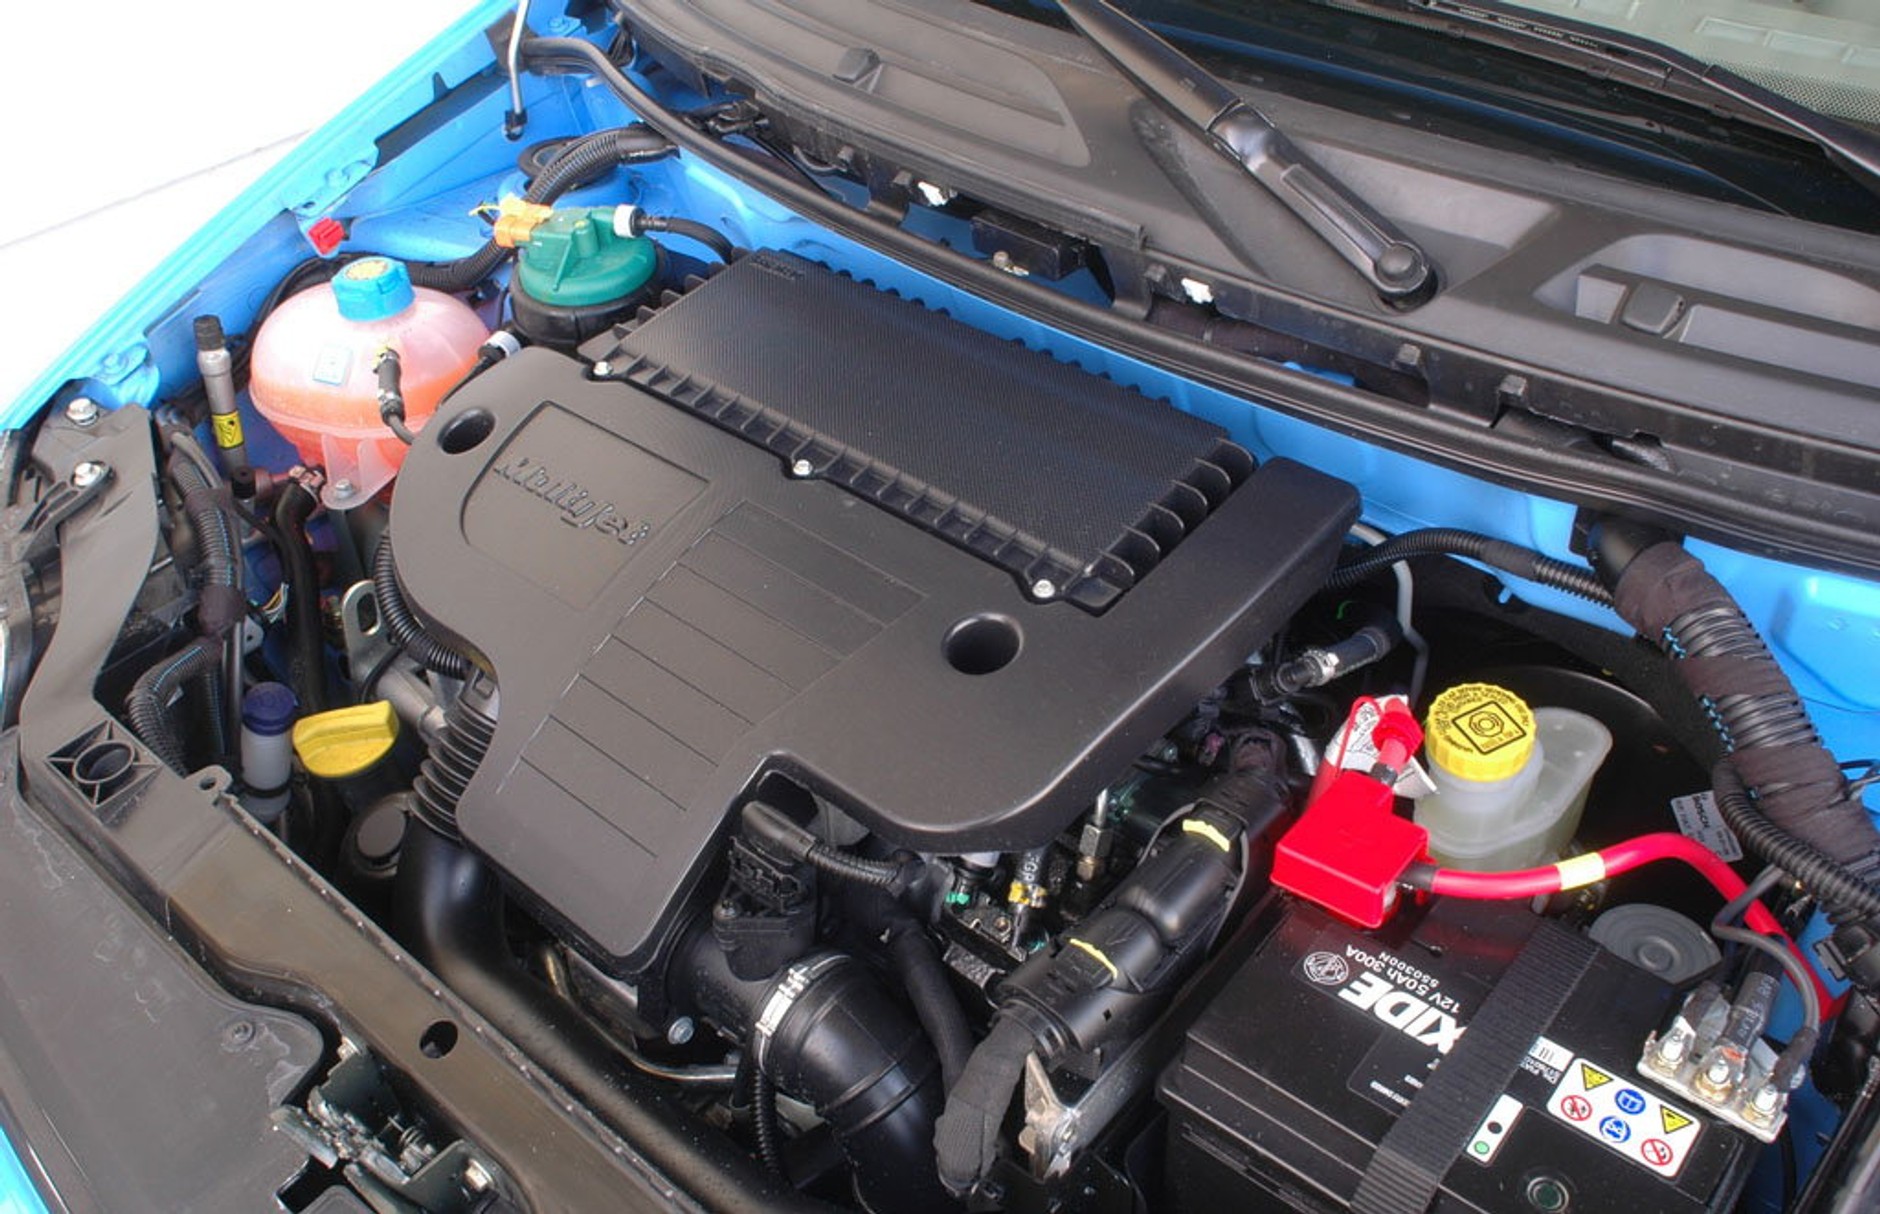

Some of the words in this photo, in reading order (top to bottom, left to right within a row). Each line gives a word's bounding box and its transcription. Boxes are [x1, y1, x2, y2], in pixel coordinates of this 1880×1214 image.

[1345, 944, 1386, 973] 300A
[1378, 951, 1440, 989] 550300N
[1386, 968, 1430, 997] 50Ah
[1338, 971, 1467, 1055] XIDE
[1429, 992, 1461, 1014] 12V
